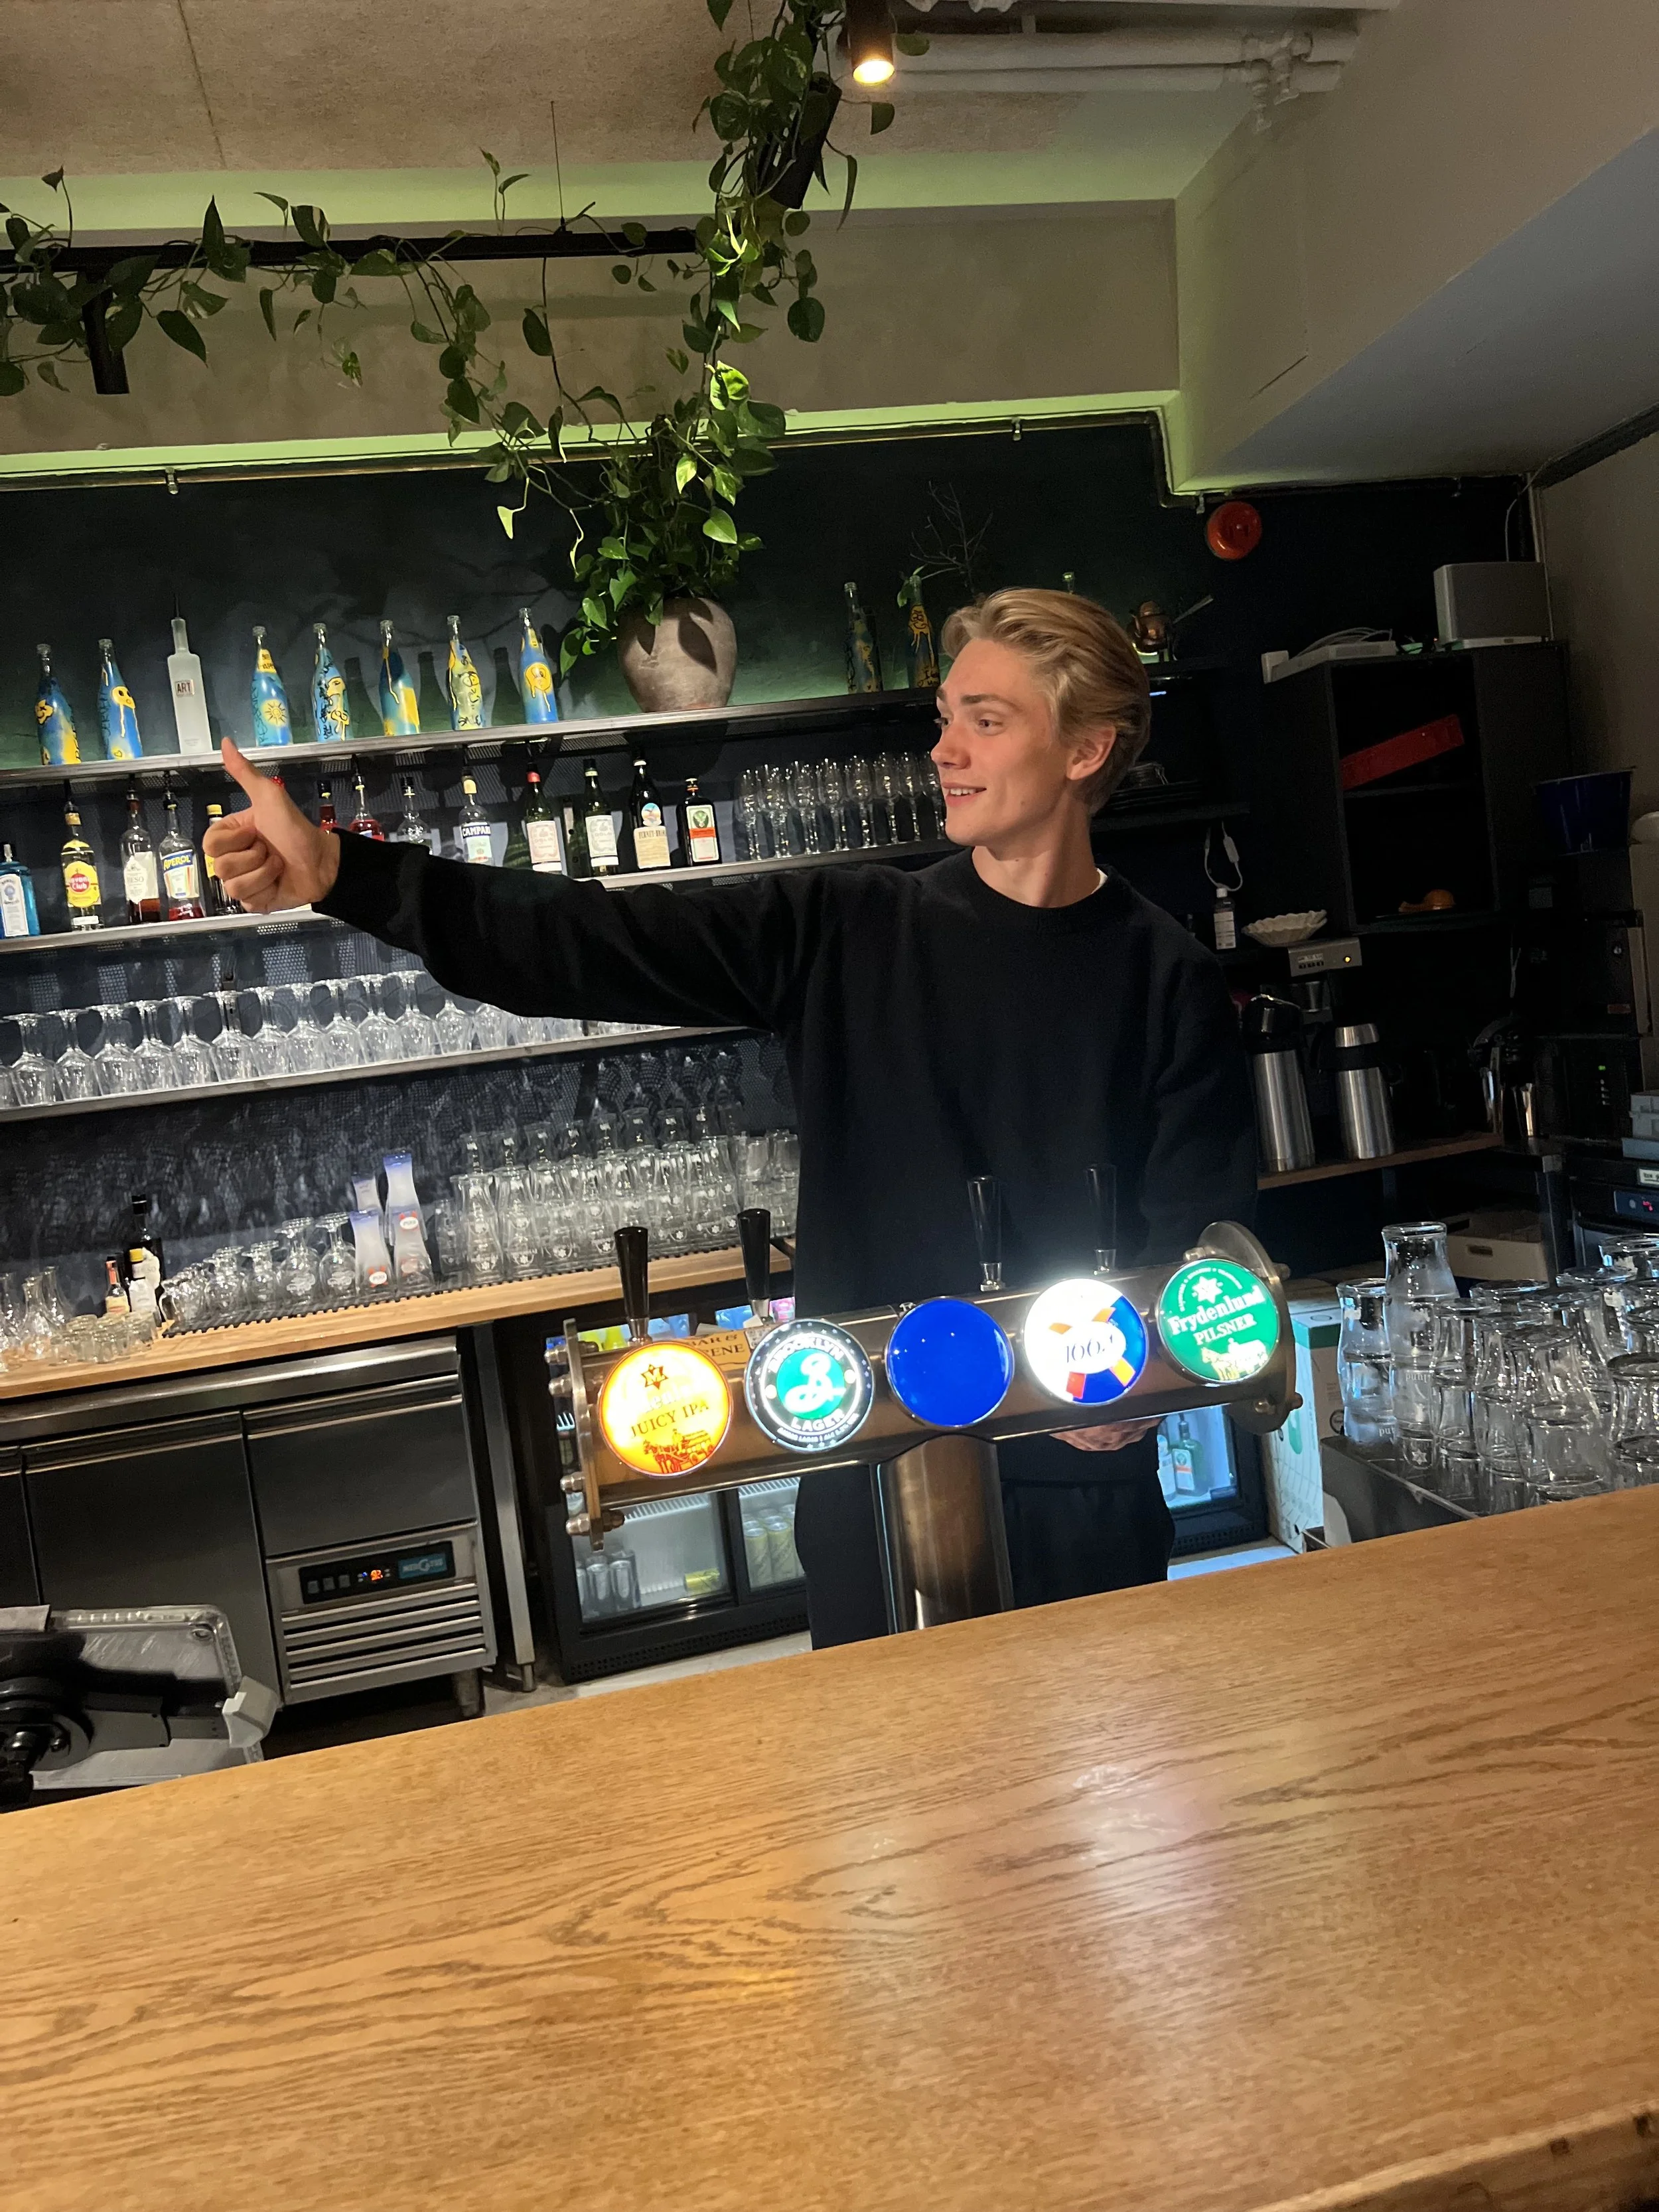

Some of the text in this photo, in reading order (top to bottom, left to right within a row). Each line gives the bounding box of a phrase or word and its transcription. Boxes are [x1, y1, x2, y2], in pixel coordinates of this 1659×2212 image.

[177, 682, 191, 694] ART
[163, 855, 191, 870] APEROL
[1167, 1285, 1265, 1335] Frydenlund
[1193, 1313, 1257, 1345] PILSNER
[768, 1336, 845, 1373] BROOKLYN
[631, 1410, 676, 1438] JUICY
[682, 1399, 709, 1418] IPA
[791, 1408, 845, 1432] LAGER
